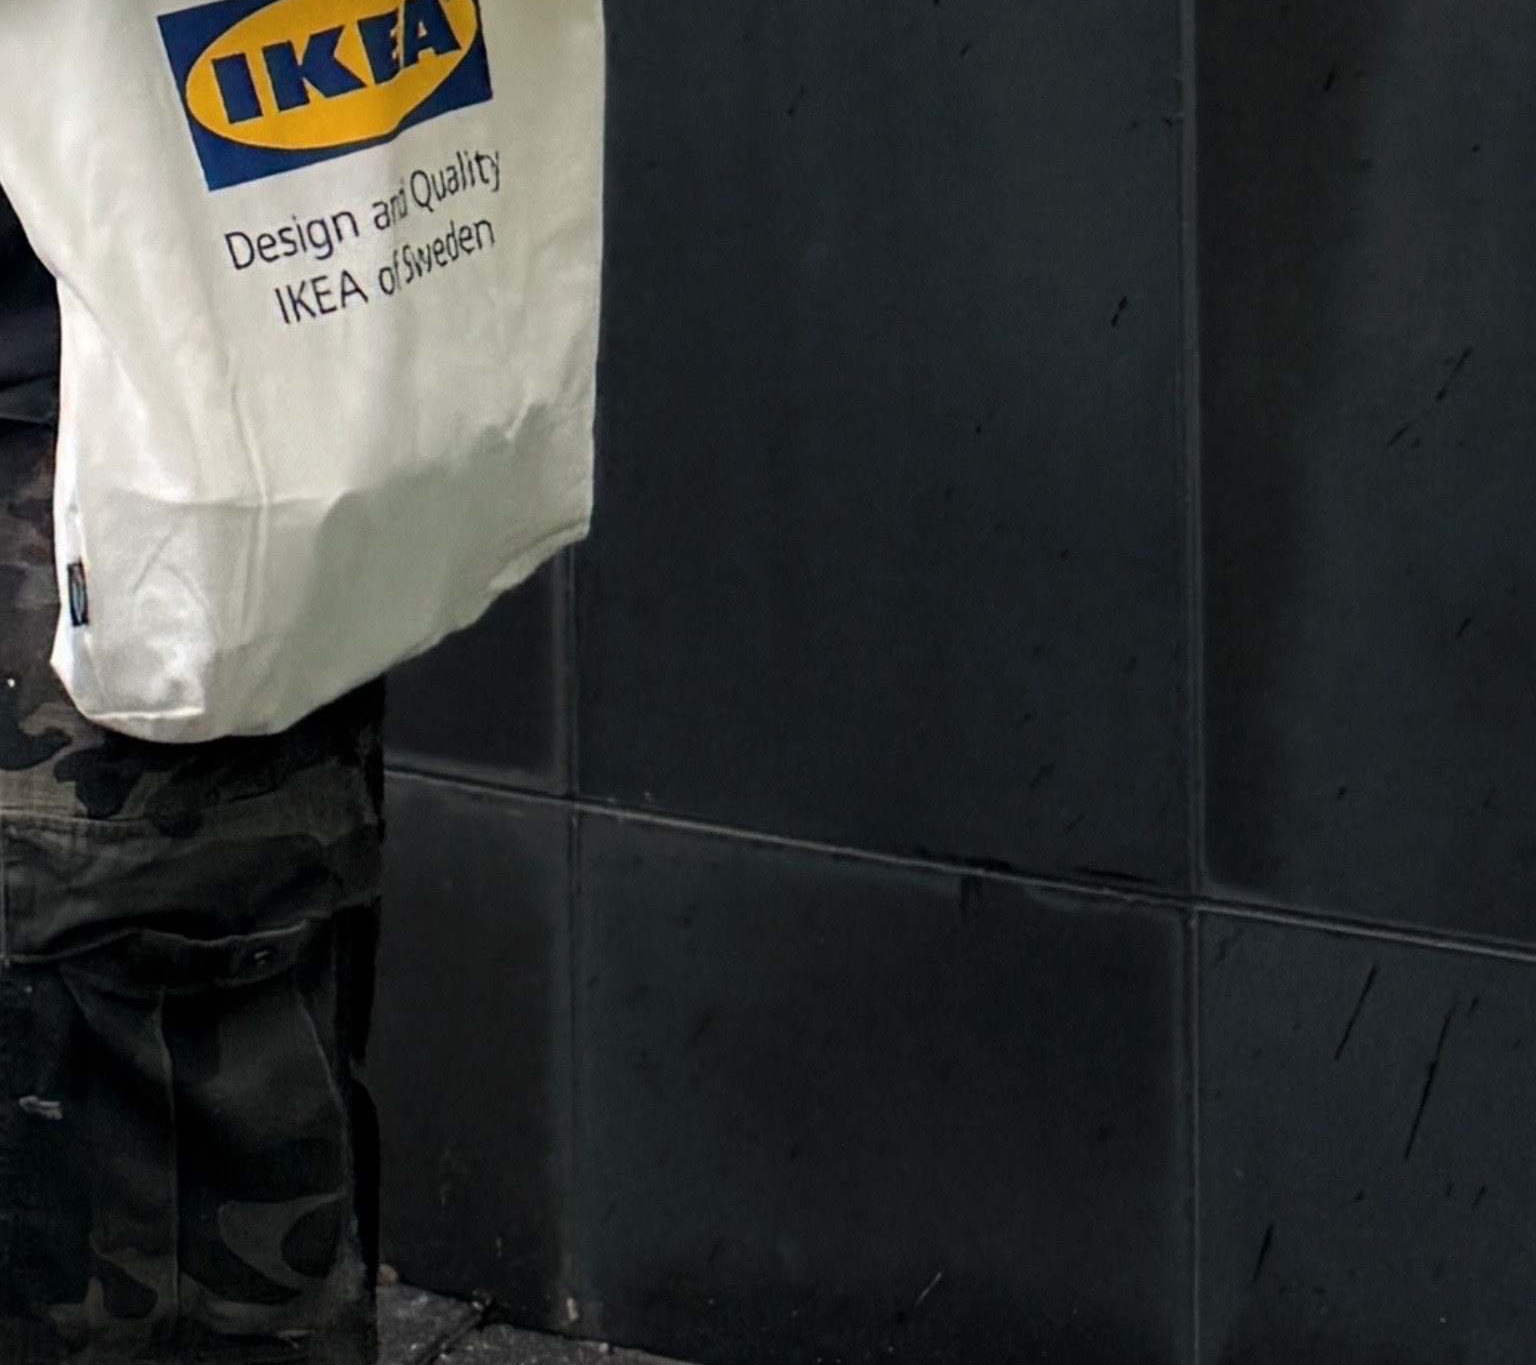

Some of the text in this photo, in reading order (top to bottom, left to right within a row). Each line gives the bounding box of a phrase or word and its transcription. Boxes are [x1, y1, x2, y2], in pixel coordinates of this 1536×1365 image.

[225, 150, 500, 270] Design and Quality
[274, 219, 495, 324] IKEA of Sweden
